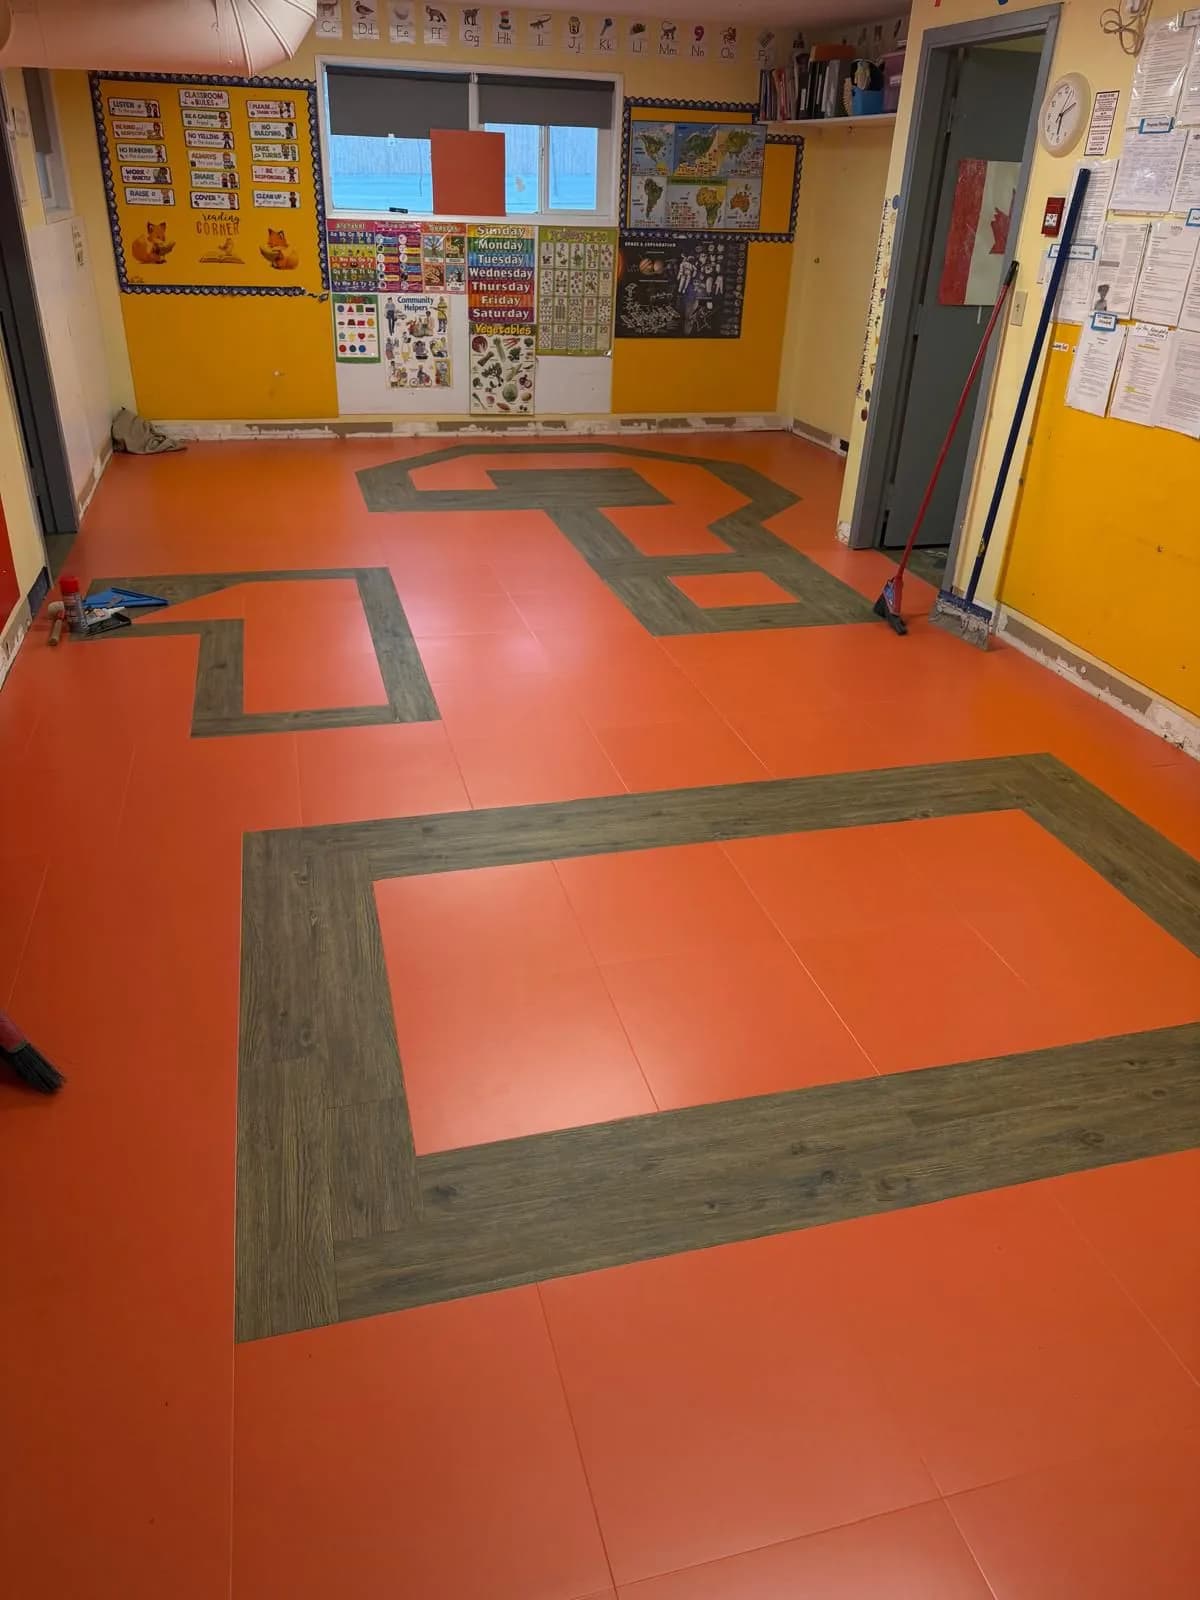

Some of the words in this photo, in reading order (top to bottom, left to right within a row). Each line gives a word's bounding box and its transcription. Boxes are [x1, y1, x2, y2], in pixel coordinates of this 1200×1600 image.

[322, 20, 336, 32] Cc
[358, 22, 373, 34] Dd
[396, 24, 408, 37] Ee
[464, 30, 480, 47] Gg
[498, 32, 512, 44] Hh
[660, 43, 677, 56] Mm
[692, 46, 704, 56] Nn
[184, 91, 224, 100] CLASSROOM
[202, 212, 240, 222] reading
[196, 220, 240, 236] CORNER
[478, 225, 524, 236] Sunday
[478, 239, 523, 252] Monday
[478, 254, 524, 266] Tuesday
[469, 267, 533, 280] Wednesday
[472, 281, 530, 294] Thursday
[397, 296, 434, 305] Community
[482, 296, 520, 305] Friday
[404, 304, 428, 312] Helpers
[473, 308, 529, 320] Saturday
[475, 322, 532, 337] Vegetables
